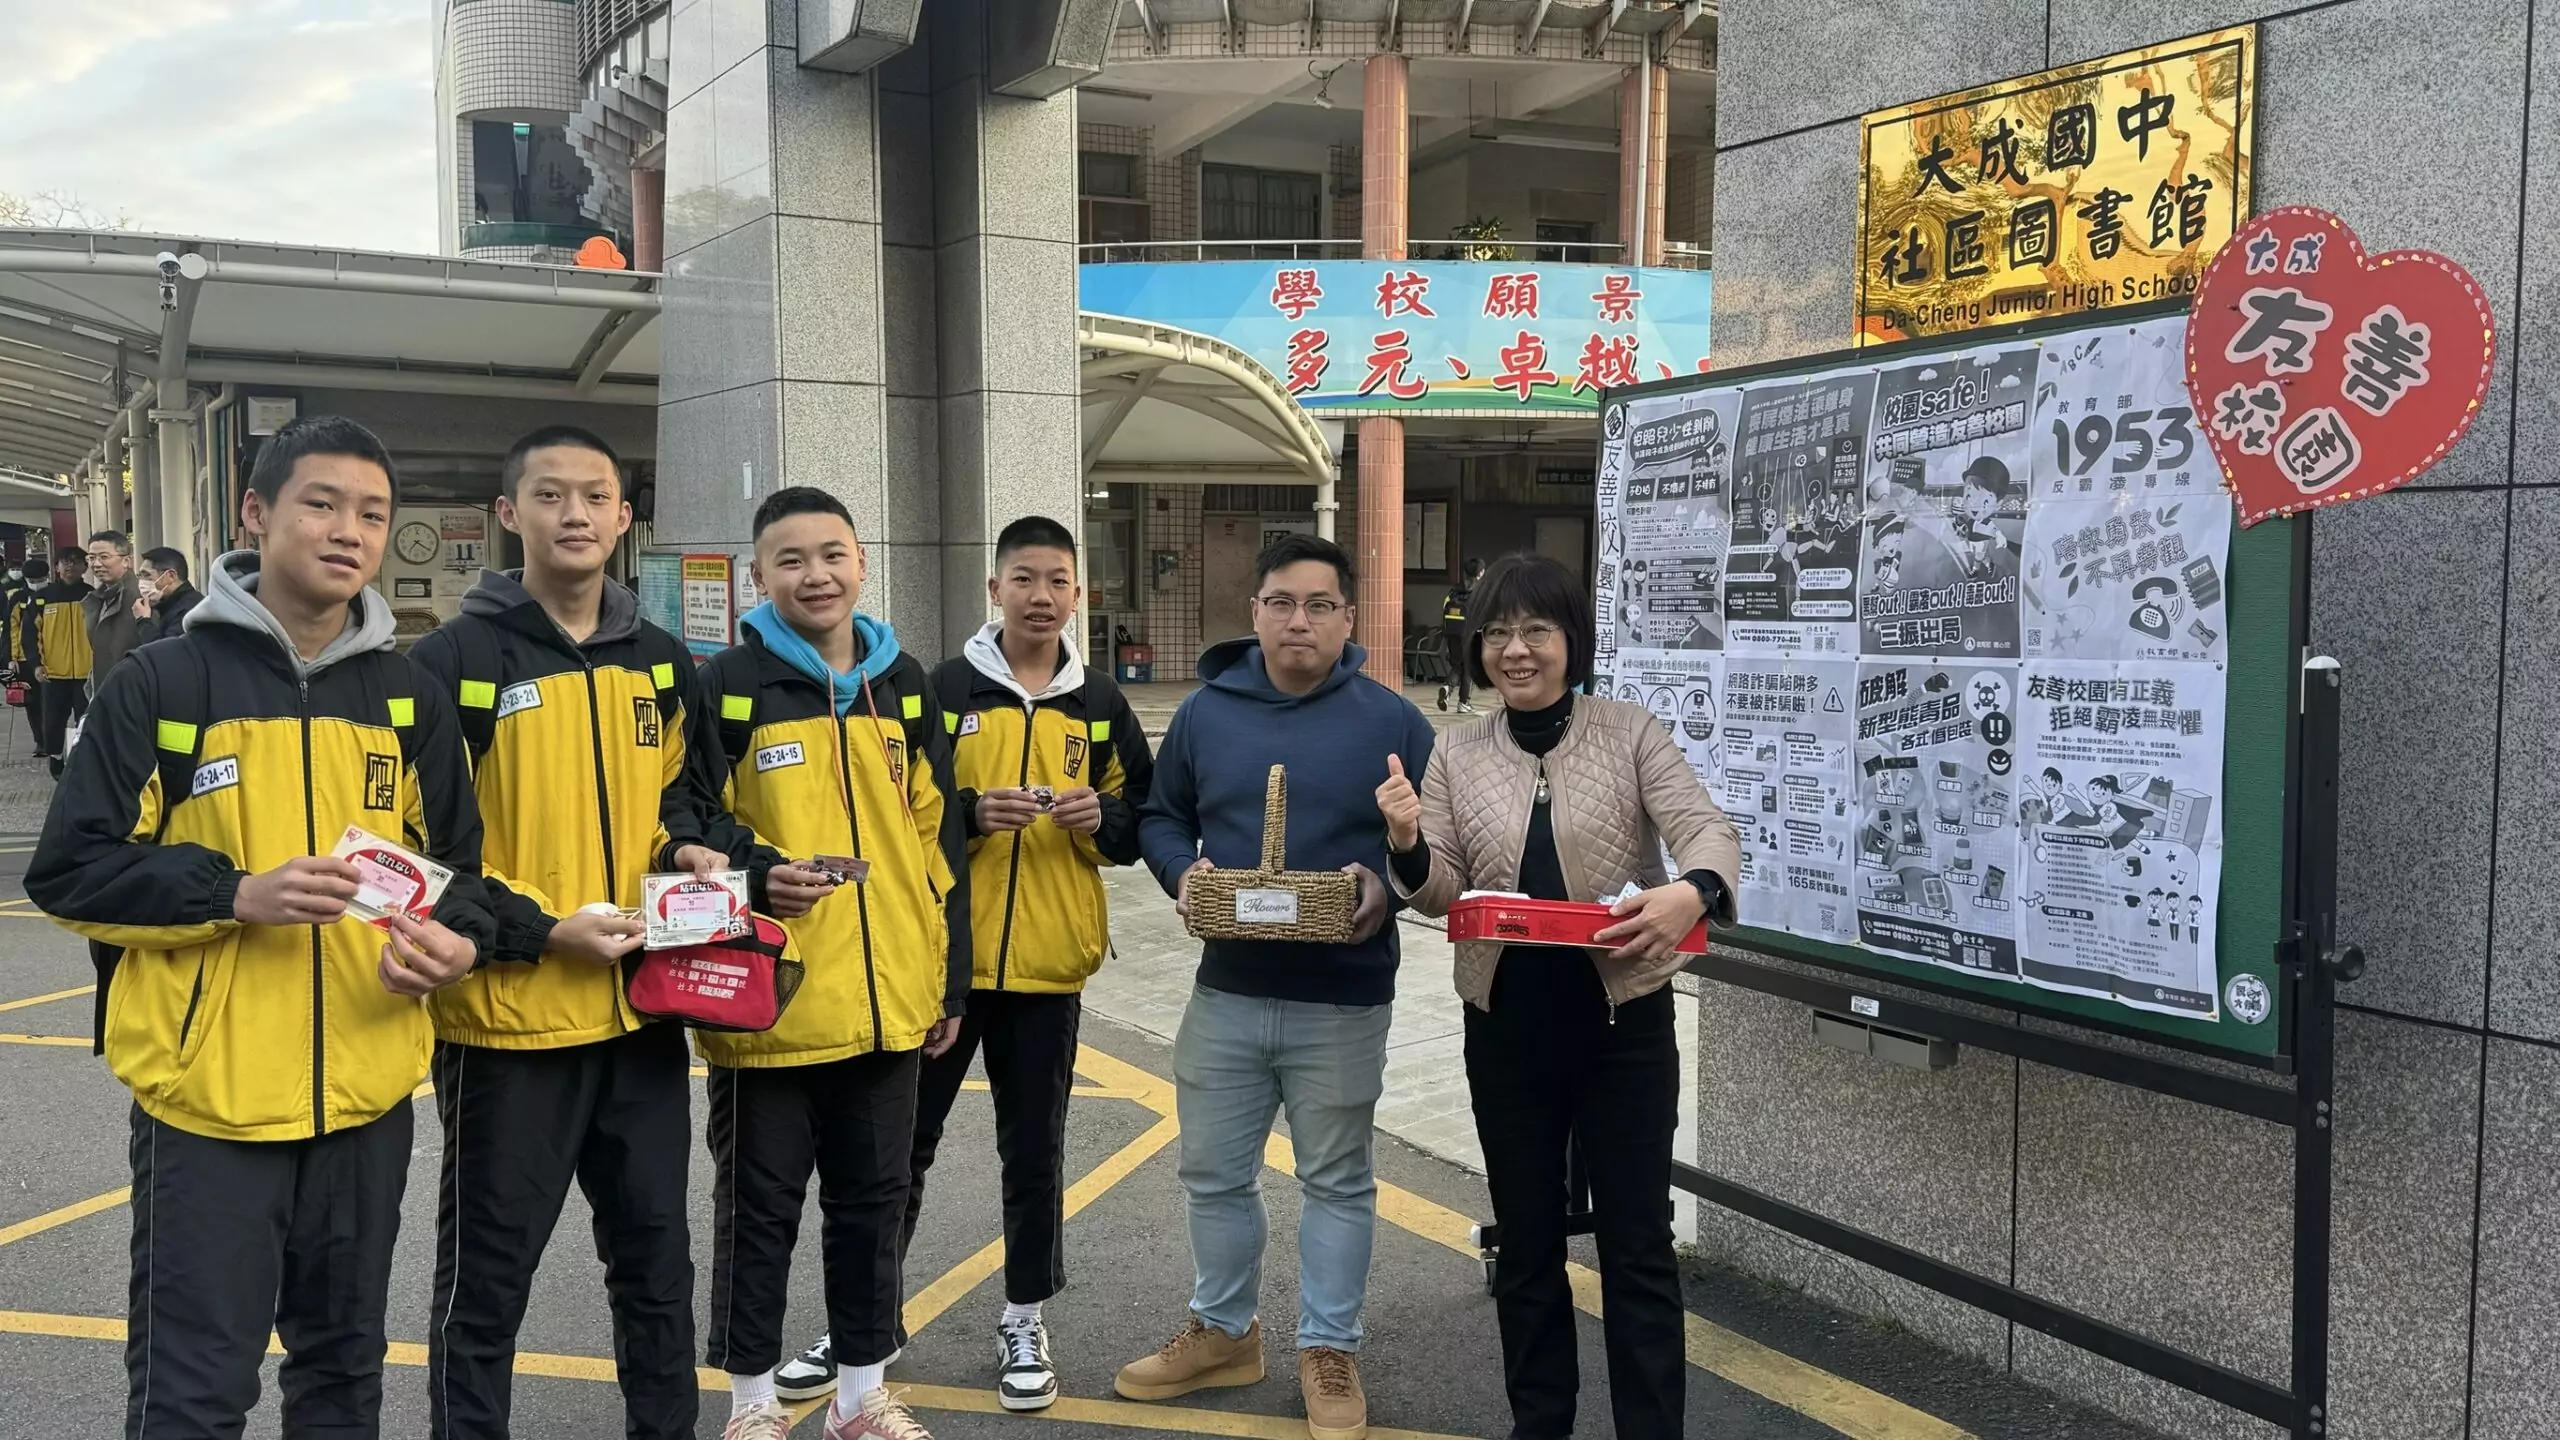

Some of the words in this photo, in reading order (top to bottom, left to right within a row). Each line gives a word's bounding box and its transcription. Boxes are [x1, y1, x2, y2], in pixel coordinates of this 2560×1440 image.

[1912, 87, 2175, 199] 大成國中
[1879, 173, 2214, 290] 社區圖書館
[2248, 231, 2326, 273] 大成
[1272, 269, 1643, 324] 學校願景
[1883, 303, 1981, 331] Da-Cheng
[1986, 291, 2057, 317] Junior
[2062, 283, 2114, 310] High
[1284, 327, 1713, 402] 多元、卓越、
[2058, 394, 2133, 414] 教育部
[1744, 412, 1852, 458] 健康生活才是真
[1874, 401, 2025, 461] 共同營造友善校園
[2052, 407, 2194, 476] 1953
[2052, 472, 2191, 493] 反霸凌專線
[1592, 440, 1622, 672] 友善校園宣導
[2052, 509, 2156, 563] 陪你勇敢
[2083, 532, 2188, 588] 不再旁觀
[1880, 616, 1962, 648] 三振出局
[1728, 672, 1819, 692] 網路詐騙陷阱多
[1860, 668, 1908, 708] 破解
[2027, 675, 2175, 707] 友善校園有正義
[1858, 693, 1961, 740] 新型態毒品
[2050, 706, 2203, 736] 拒絕霸凌無畏懼
[194, 764, 235, 790] 112-24-17
[759, 746, 799, 765] 112-24-15
[1243, 897, 1292, 914] Flowers
[1788, 875, 1848, 896] 165反詐騙專線
